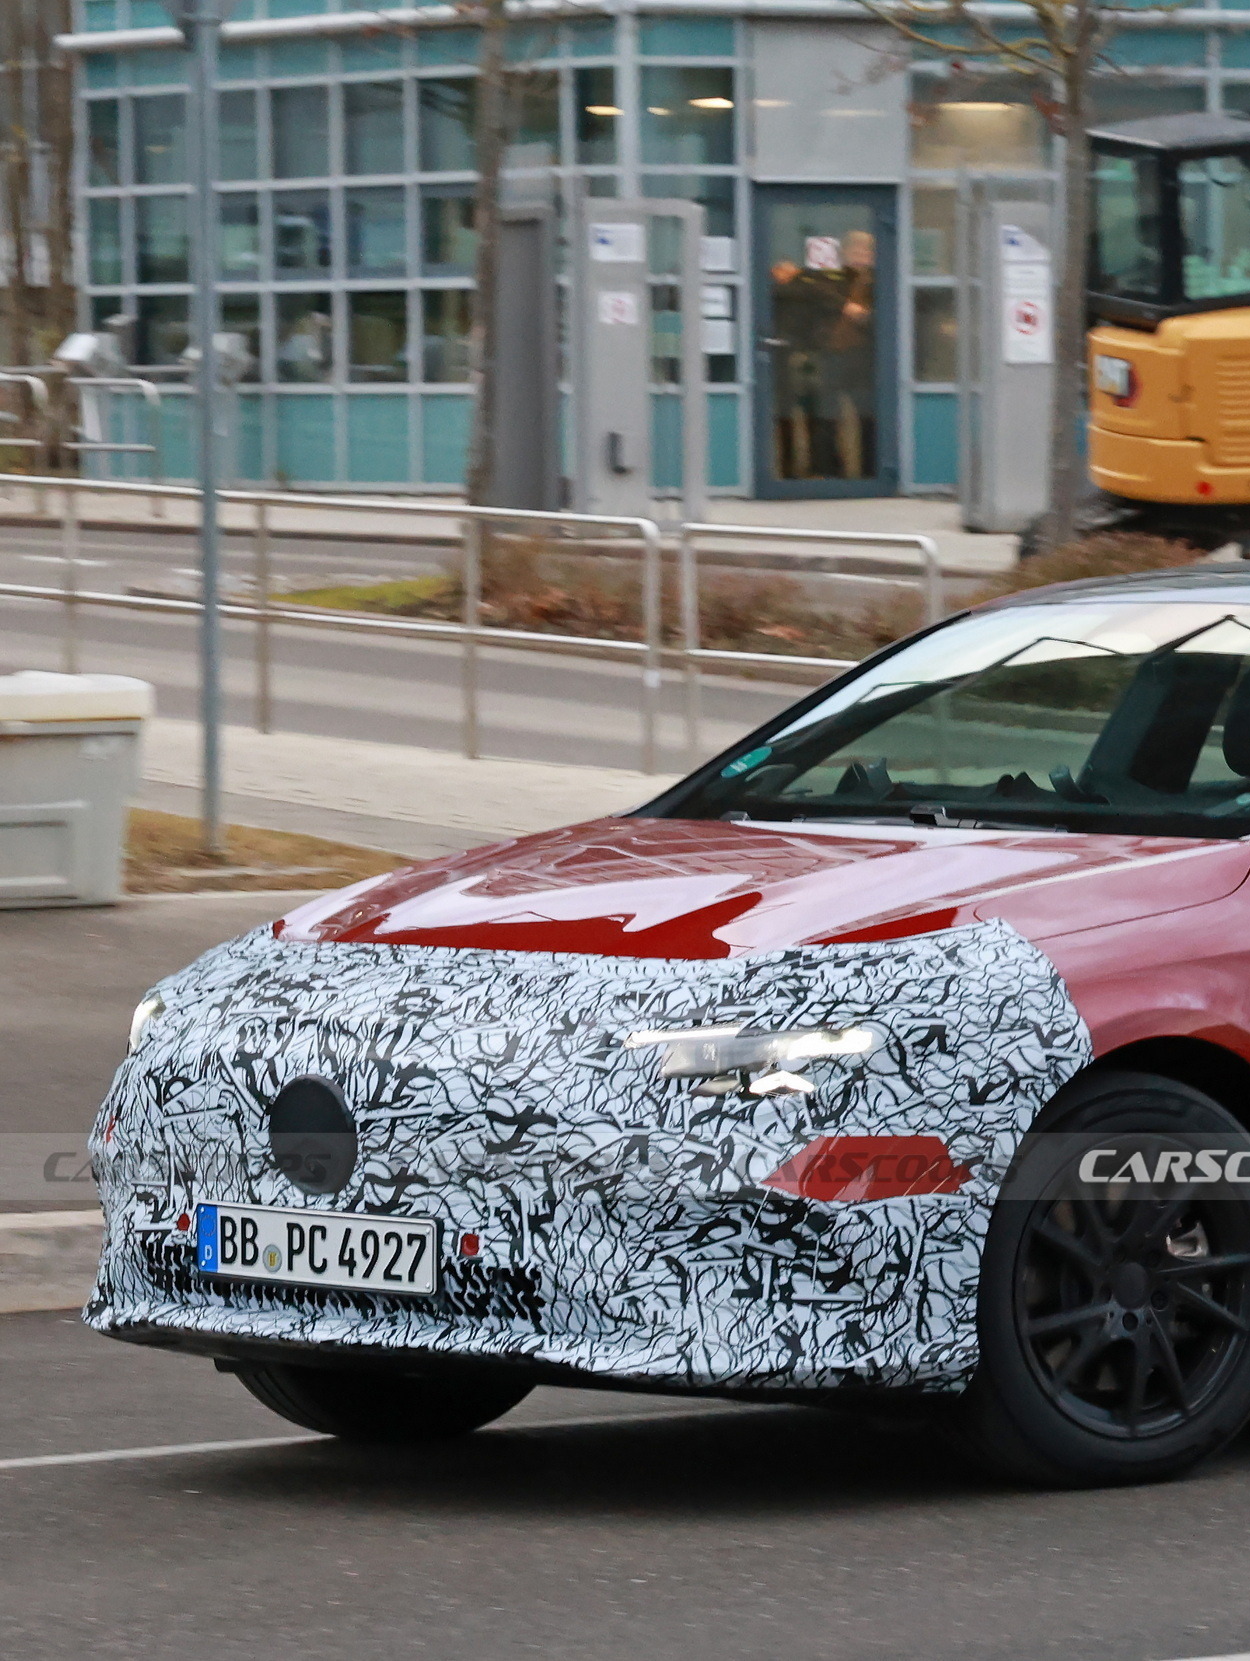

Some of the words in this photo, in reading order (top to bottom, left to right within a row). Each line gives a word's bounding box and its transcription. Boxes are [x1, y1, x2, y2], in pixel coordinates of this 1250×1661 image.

[204, 1245, 213, 1260] D
[220, 1215, 259, 1267] BB
[286, 1222, 328, 1275] PC
[338, 1227, 427, 1282] 4927
